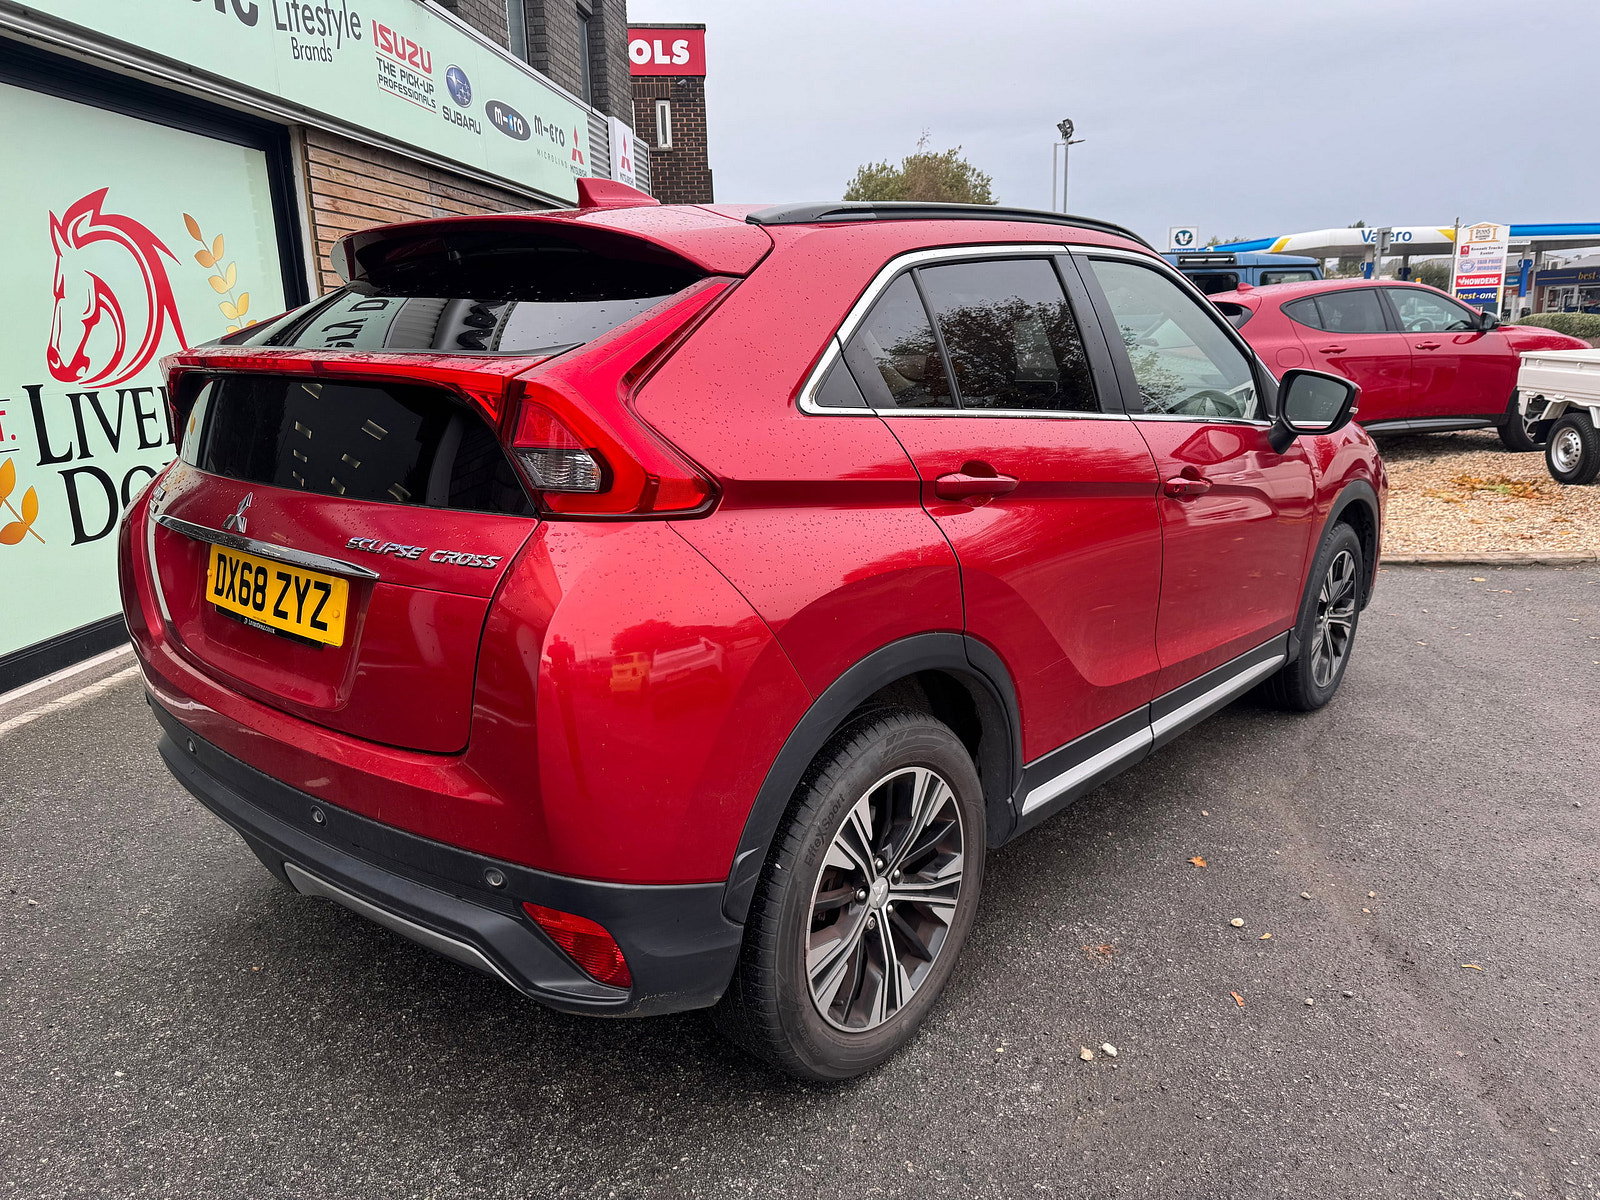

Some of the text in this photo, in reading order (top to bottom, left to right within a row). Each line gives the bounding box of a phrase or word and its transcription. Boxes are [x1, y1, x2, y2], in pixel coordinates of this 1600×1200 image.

[291, 37, 333, 62] Brands
[372, 19, 432, 74] ISUZU
[376, 57, 435, 95] THE PICK-UP
[378, 74, 436, 109] PROFESSIONALS
[442, 105, 482, 135] SUBARU
[1361, 229, 1413, 243] Varo
[1464, 276, 1499, 285] HOWDENS
[1578, 271, 1600, 280] best-
[1457, 292, 1497, 300] best-one
[345, 536, 504, 569] ECLIPSE CROSS
[213, 552, 332, 632] DX68 ZYZ
